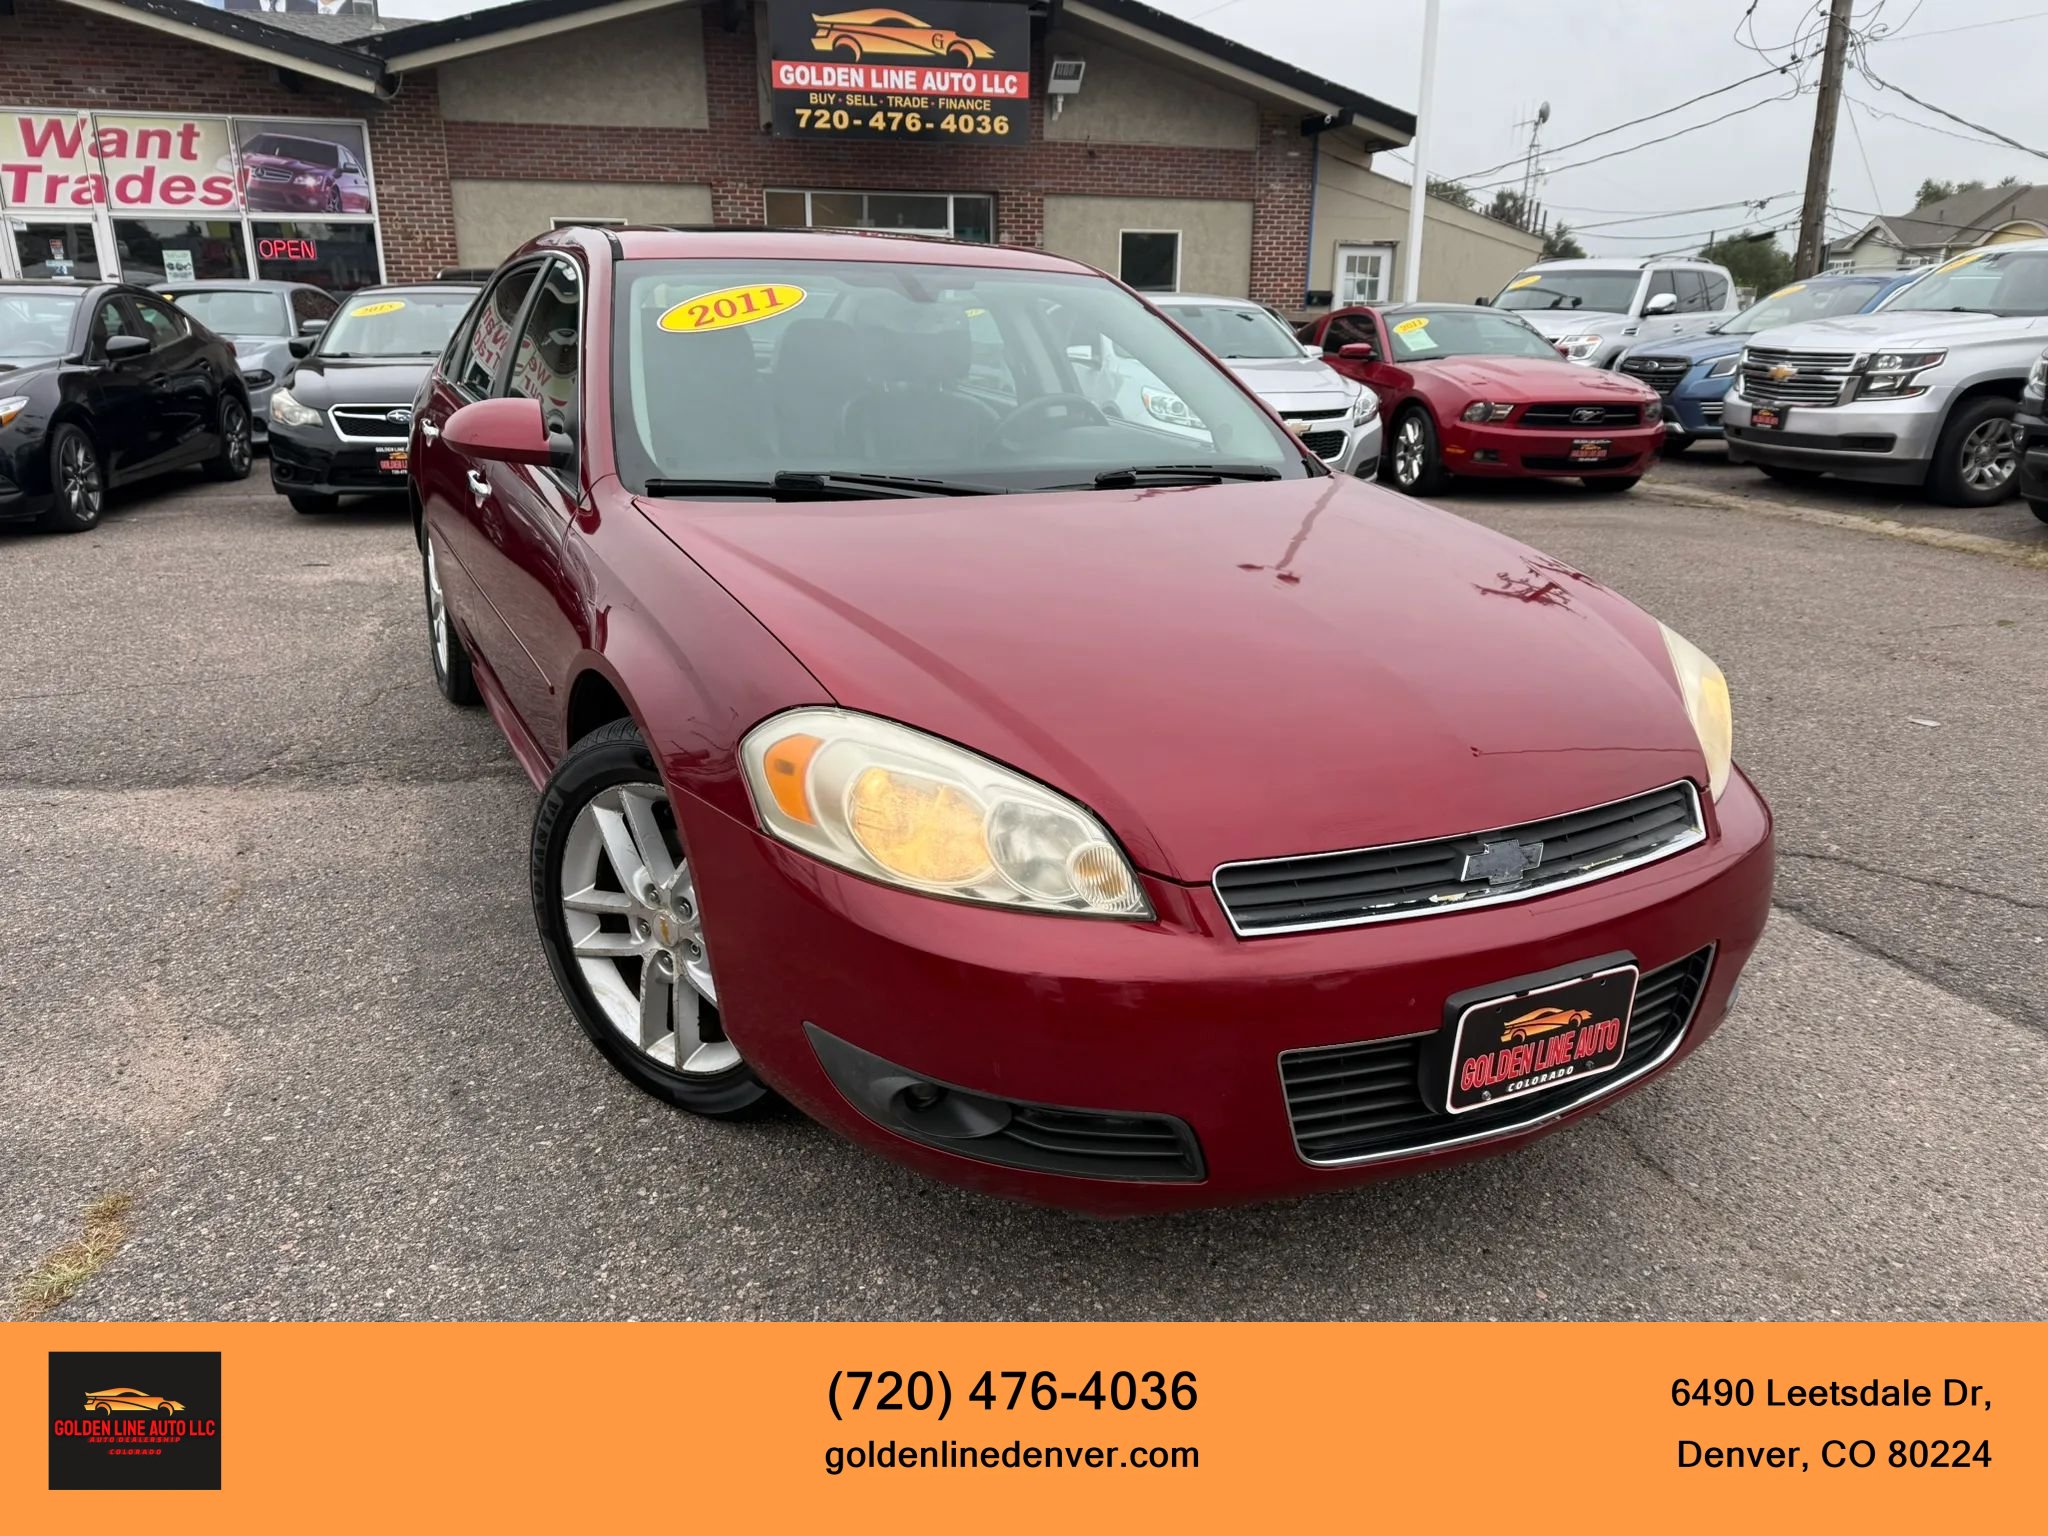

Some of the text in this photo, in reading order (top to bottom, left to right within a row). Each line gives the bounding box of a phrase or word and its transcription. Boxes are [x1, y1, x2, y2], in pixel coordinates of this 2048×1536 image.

[779, 64, 1018, 95] GOLDEN LINE AUTO LLC
[809, 93, 991, 111] BUY SELL TRADE FINANCE
[18, 117, 201, 161] Want
[1, 163, 251, 206] Trades!
[259, 239, 316, 260] OPEN
[687, 287, 784, 328] 2011
[1461, 1018, 1620, 1091] GOLDEN LINE AUTO
[1507, 1065, 1574, 1092] COLORADO
